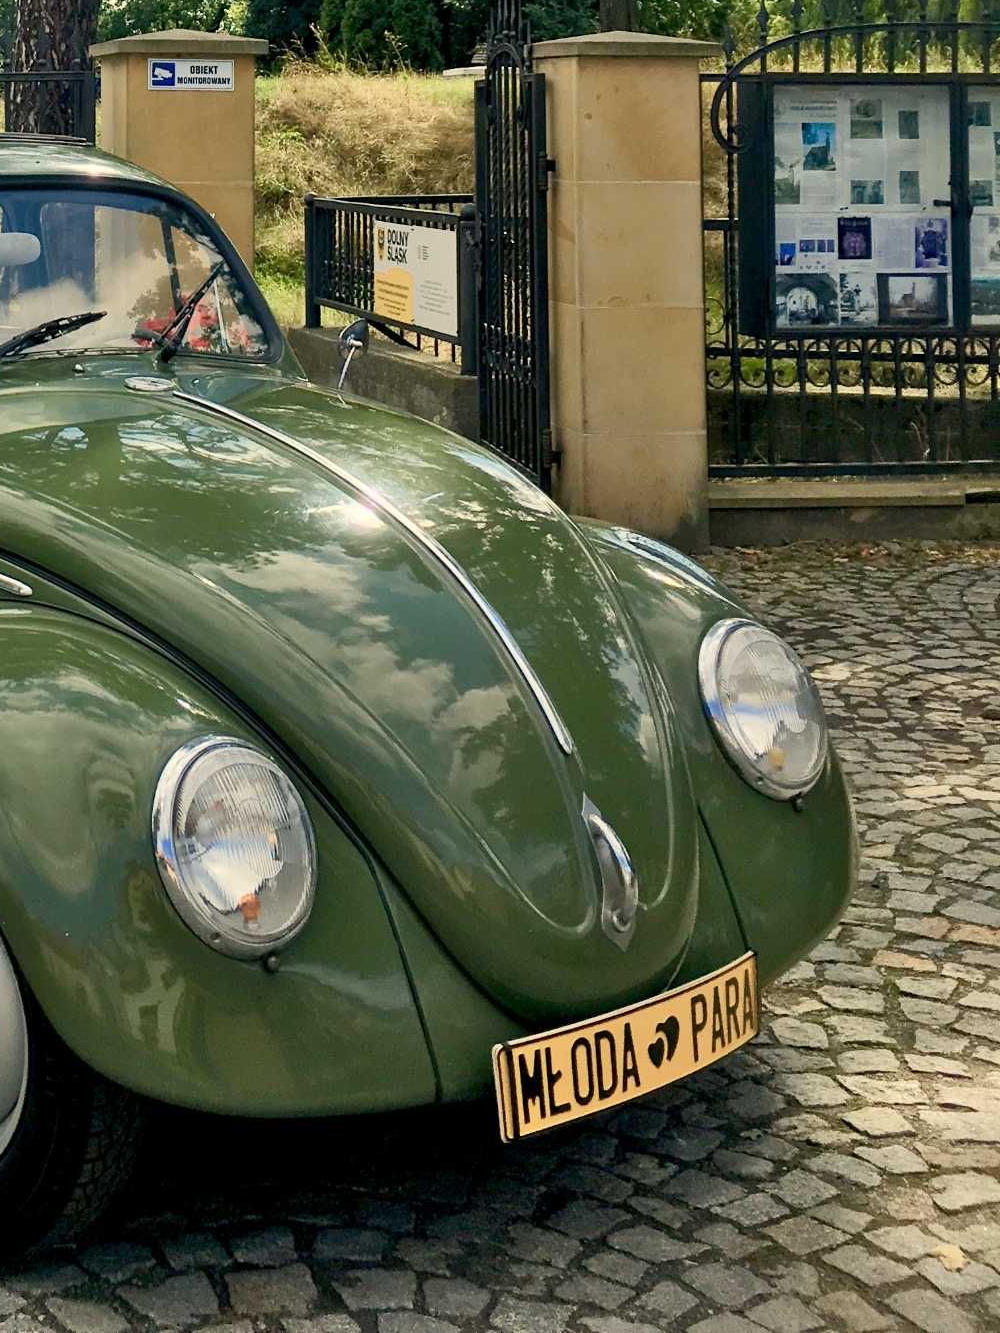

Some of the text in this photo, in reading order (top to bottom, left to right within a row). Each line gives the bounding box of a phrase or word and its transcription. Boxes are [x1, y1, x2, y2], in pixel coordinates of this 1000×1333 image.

[190, 65, 218, 75] OBIEKT
[177, 76, 231, 85] MONITOROWANY
[387, 228, 409, 247] DOLNY
[518, 969, 754, 1125] MŁODA PARA
